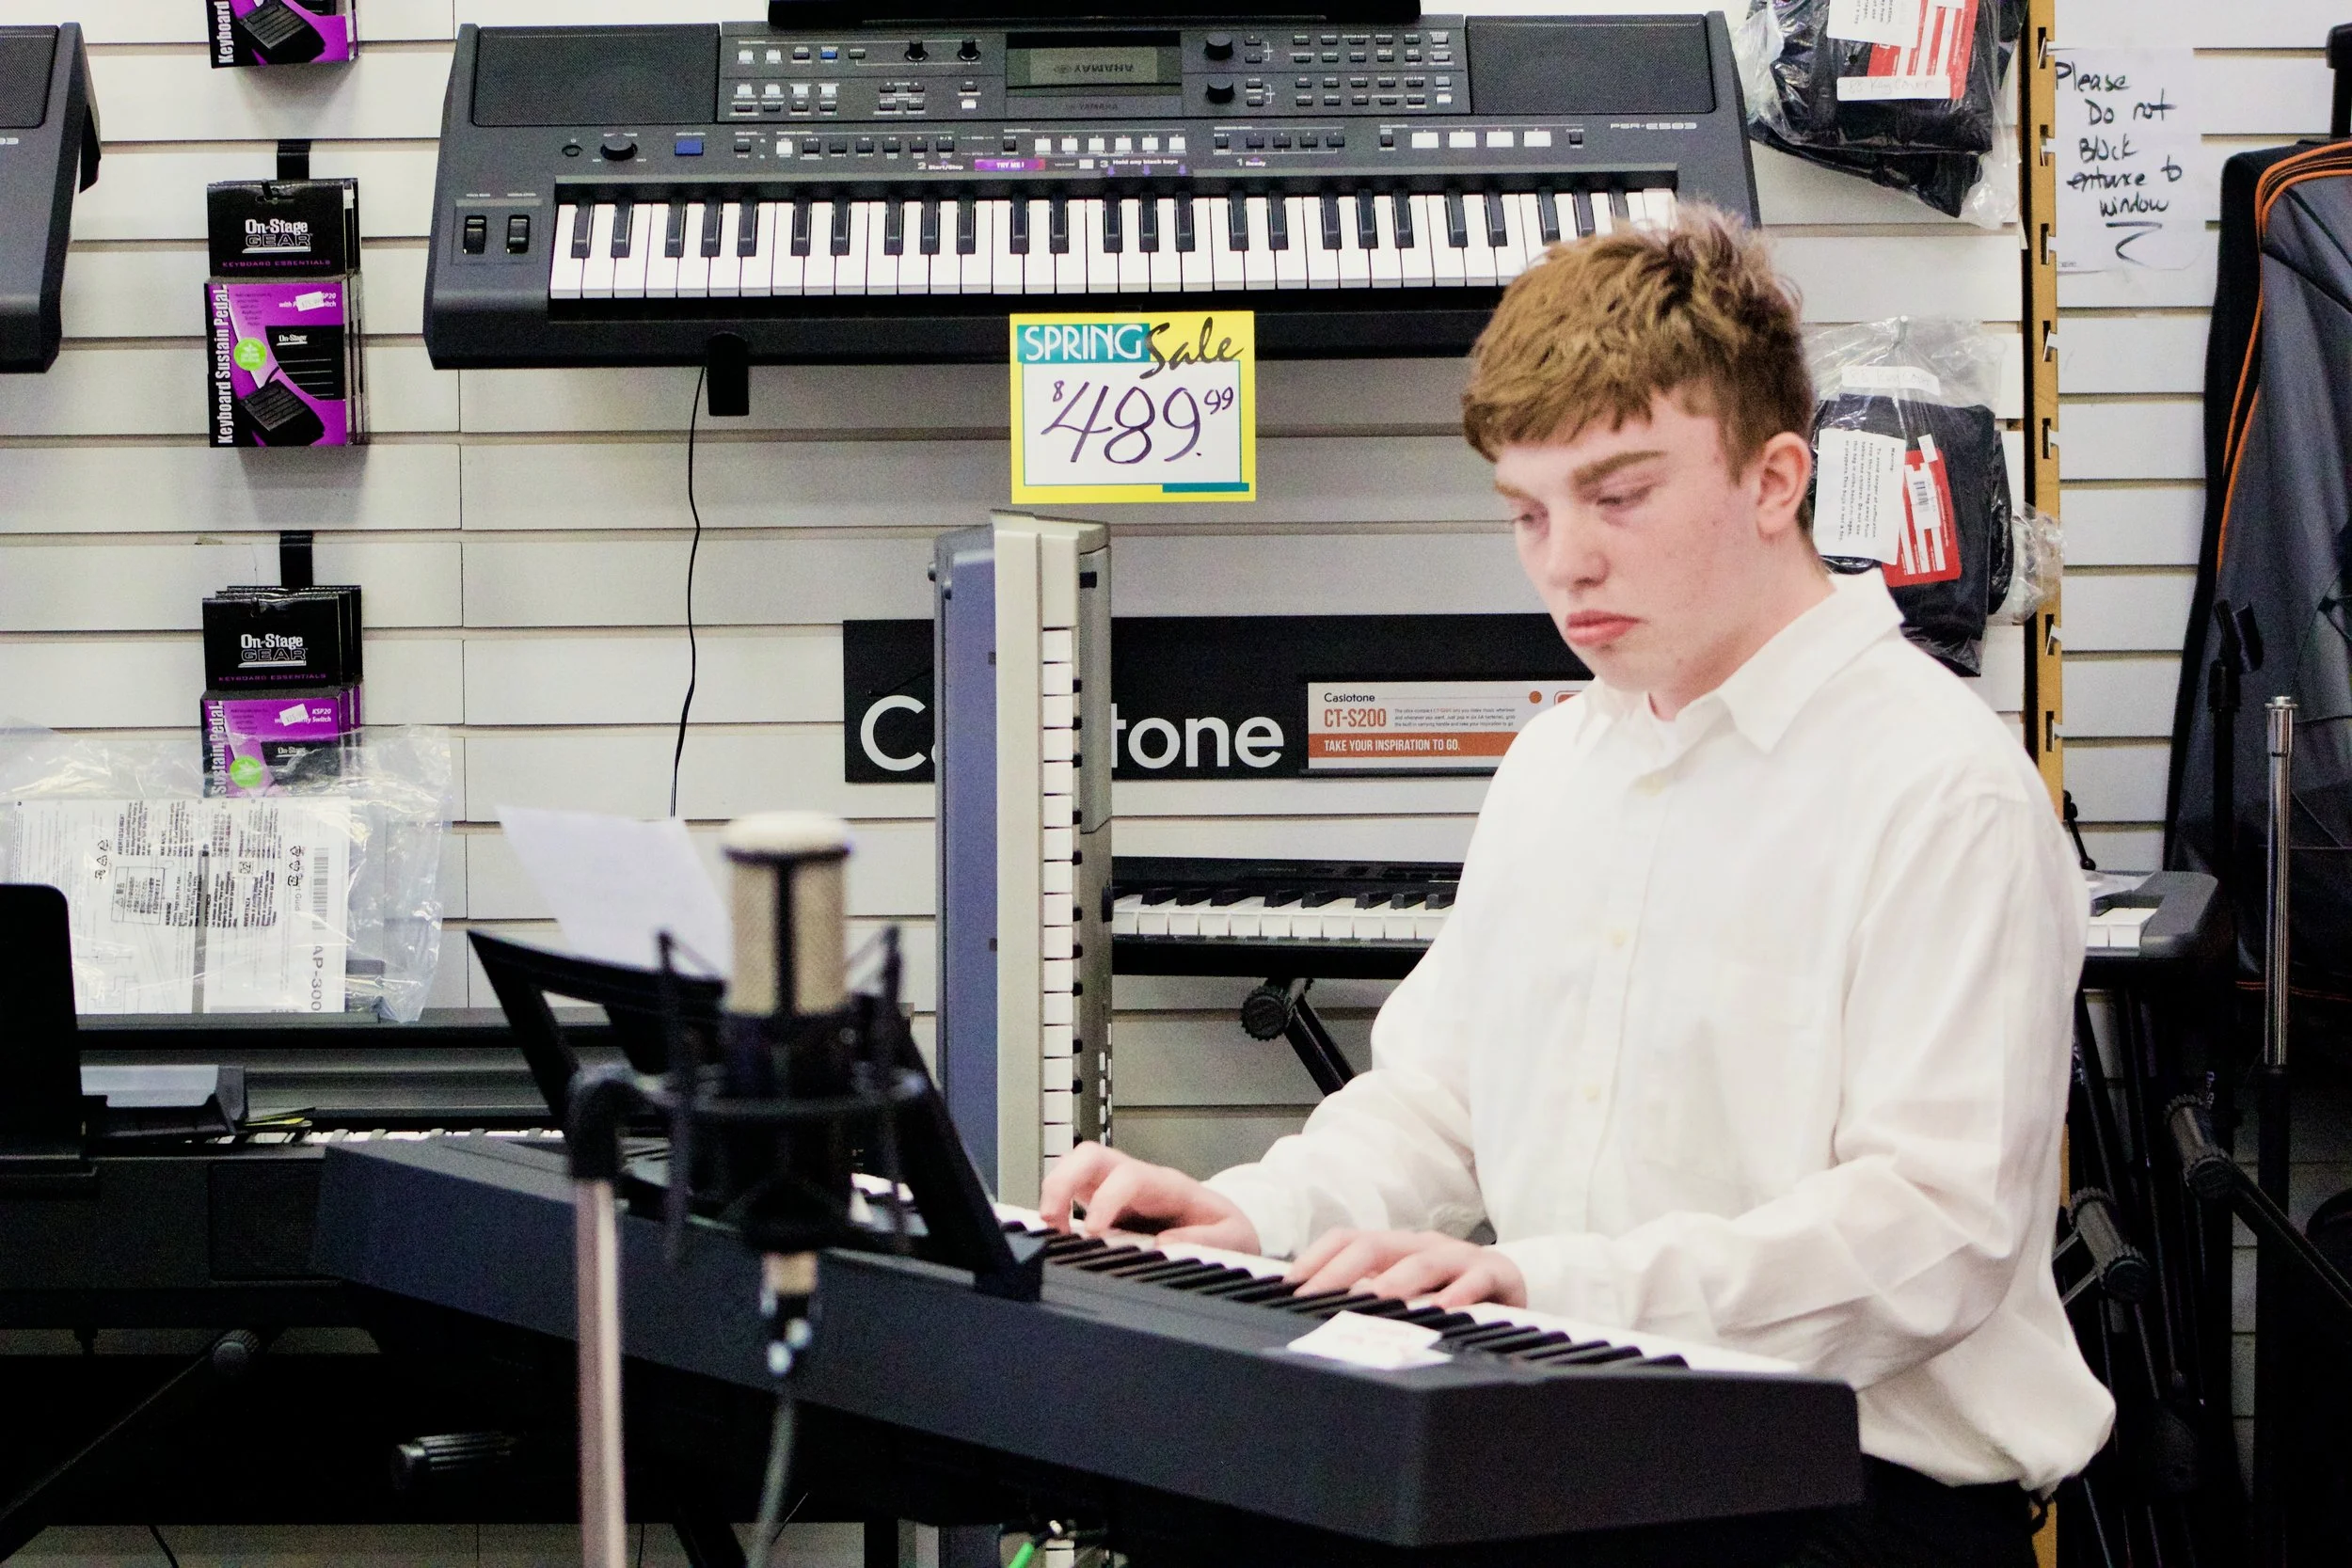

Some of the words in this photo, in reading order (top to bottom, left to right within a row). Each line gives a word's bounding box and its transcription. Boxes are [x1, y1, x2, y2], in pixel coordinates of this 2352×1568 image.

[216, 0, 233, 64] Keyboard
[2055, 61, 2132, 92] Please
[2085, 98, 2115, 125] Do
[2133, 87, 2177, 120] not
[2161, 154, 2183, 182] to
[2099, 191, 2169, 218] window
[245, 218, 309, 235] On-Stage
[245, 233, 311, 247] GEAR
[213, 287, 228, 325] Pedal
[215, 329, 231, 379] Sustain
[1025, 324, 1144, 361] SPRING
[1139, 316, 1245, 379] Sale
[217, 381, 233, 444] Keyboard
[240, 633, 304, 649] On-Stage
[241, 647, 307, 662] GEAR
[209, 702, 226, 740] Pedal
[1325, 707, 1387, 728] CT-S200
[1324, 739, 1347, 752] TAKE
[1349, 739, 1373, 752] YOUR
[1375, 739, 1430, 752] INSPIRATION
[1433, 739, 1444, 751] TO
[1446, 739, 1460, 751] GO.
[310, 944, 324, 1011] AP-300
